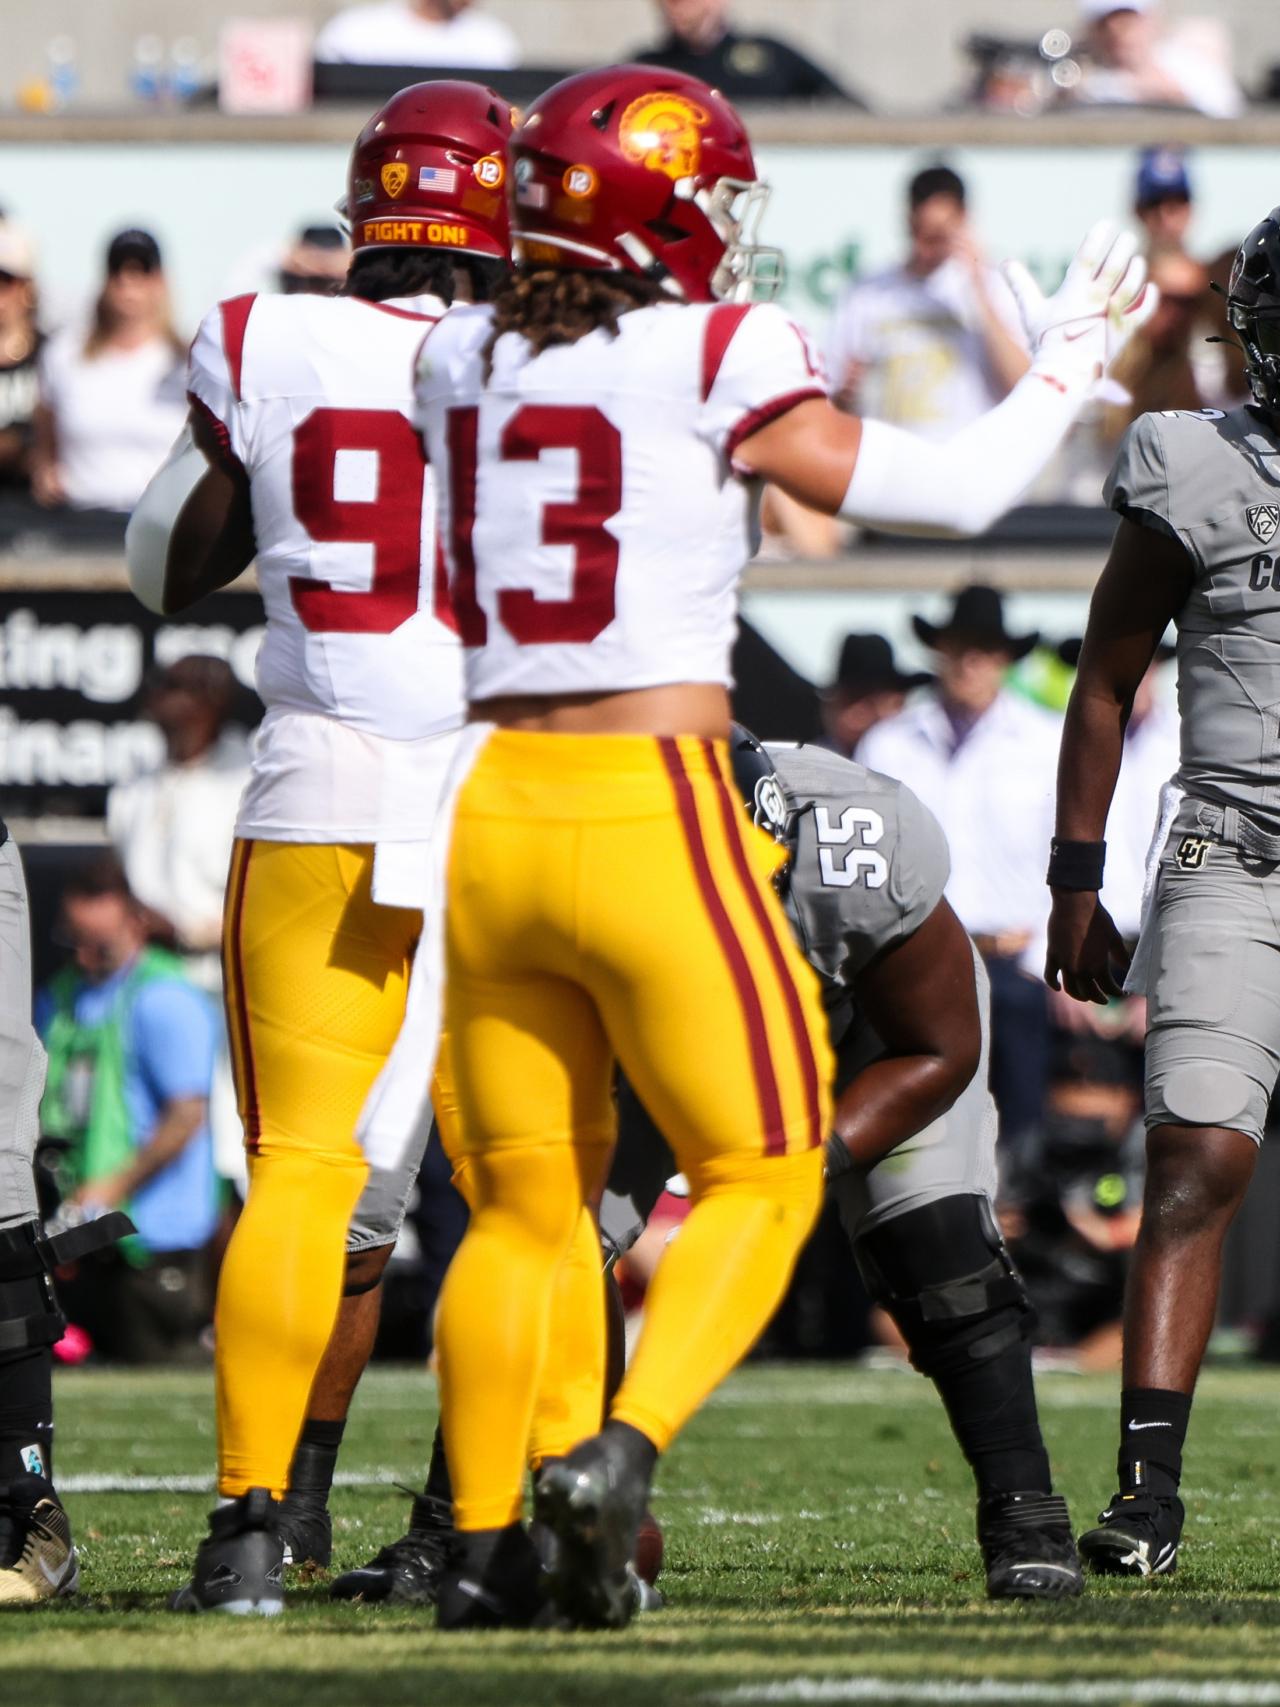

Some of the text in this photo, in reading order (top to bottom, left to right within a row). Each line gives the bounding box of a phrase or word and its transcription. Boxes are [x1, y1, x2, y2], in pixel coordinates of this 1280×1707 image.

[480, 161, 498, 183] 12
[569, 170, 590, 192] 12
[364, 223, 467, 246] FIGHT ON!
[288, 406, 464, 636] 9
[445, 404, 623, 648] 13
[814, 805, 889, 889] 55
